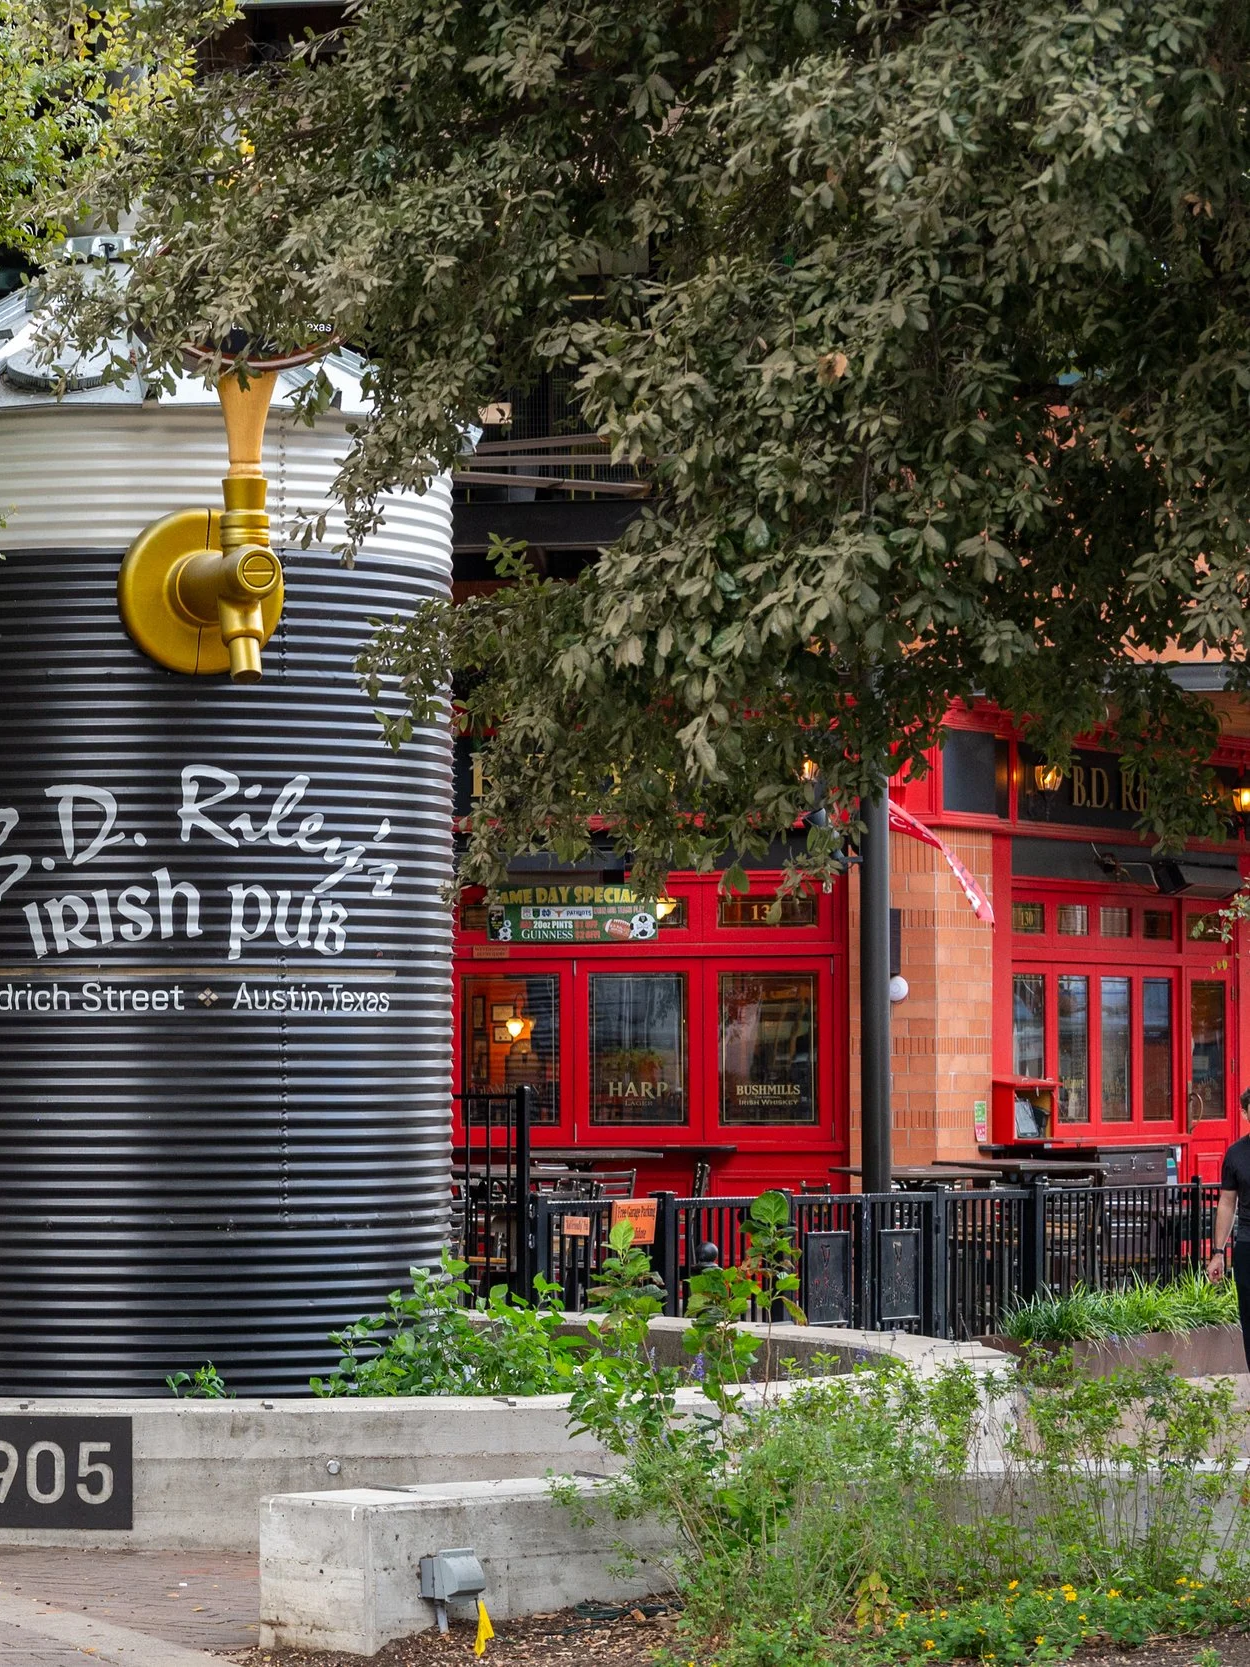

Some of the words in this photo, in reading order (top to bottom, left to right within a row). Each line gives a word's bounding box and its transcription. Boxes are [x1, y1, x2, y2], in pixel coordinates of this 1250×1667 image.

[1072, 765, 1114, 810] B.D.
[177, 763, 400, 898] Riley's
[499, 888, 535, 905] AME
[535, 886, 571, 905] DAY
[551, 920, 574, 929] PINTS
[521, 929, 574, 940] GUINNESS
[81, 983, 186, 1011] Street
[609, 1081, 670, 1099] HARP
[736, 1084, 801, 1096] BUSHMILLS
